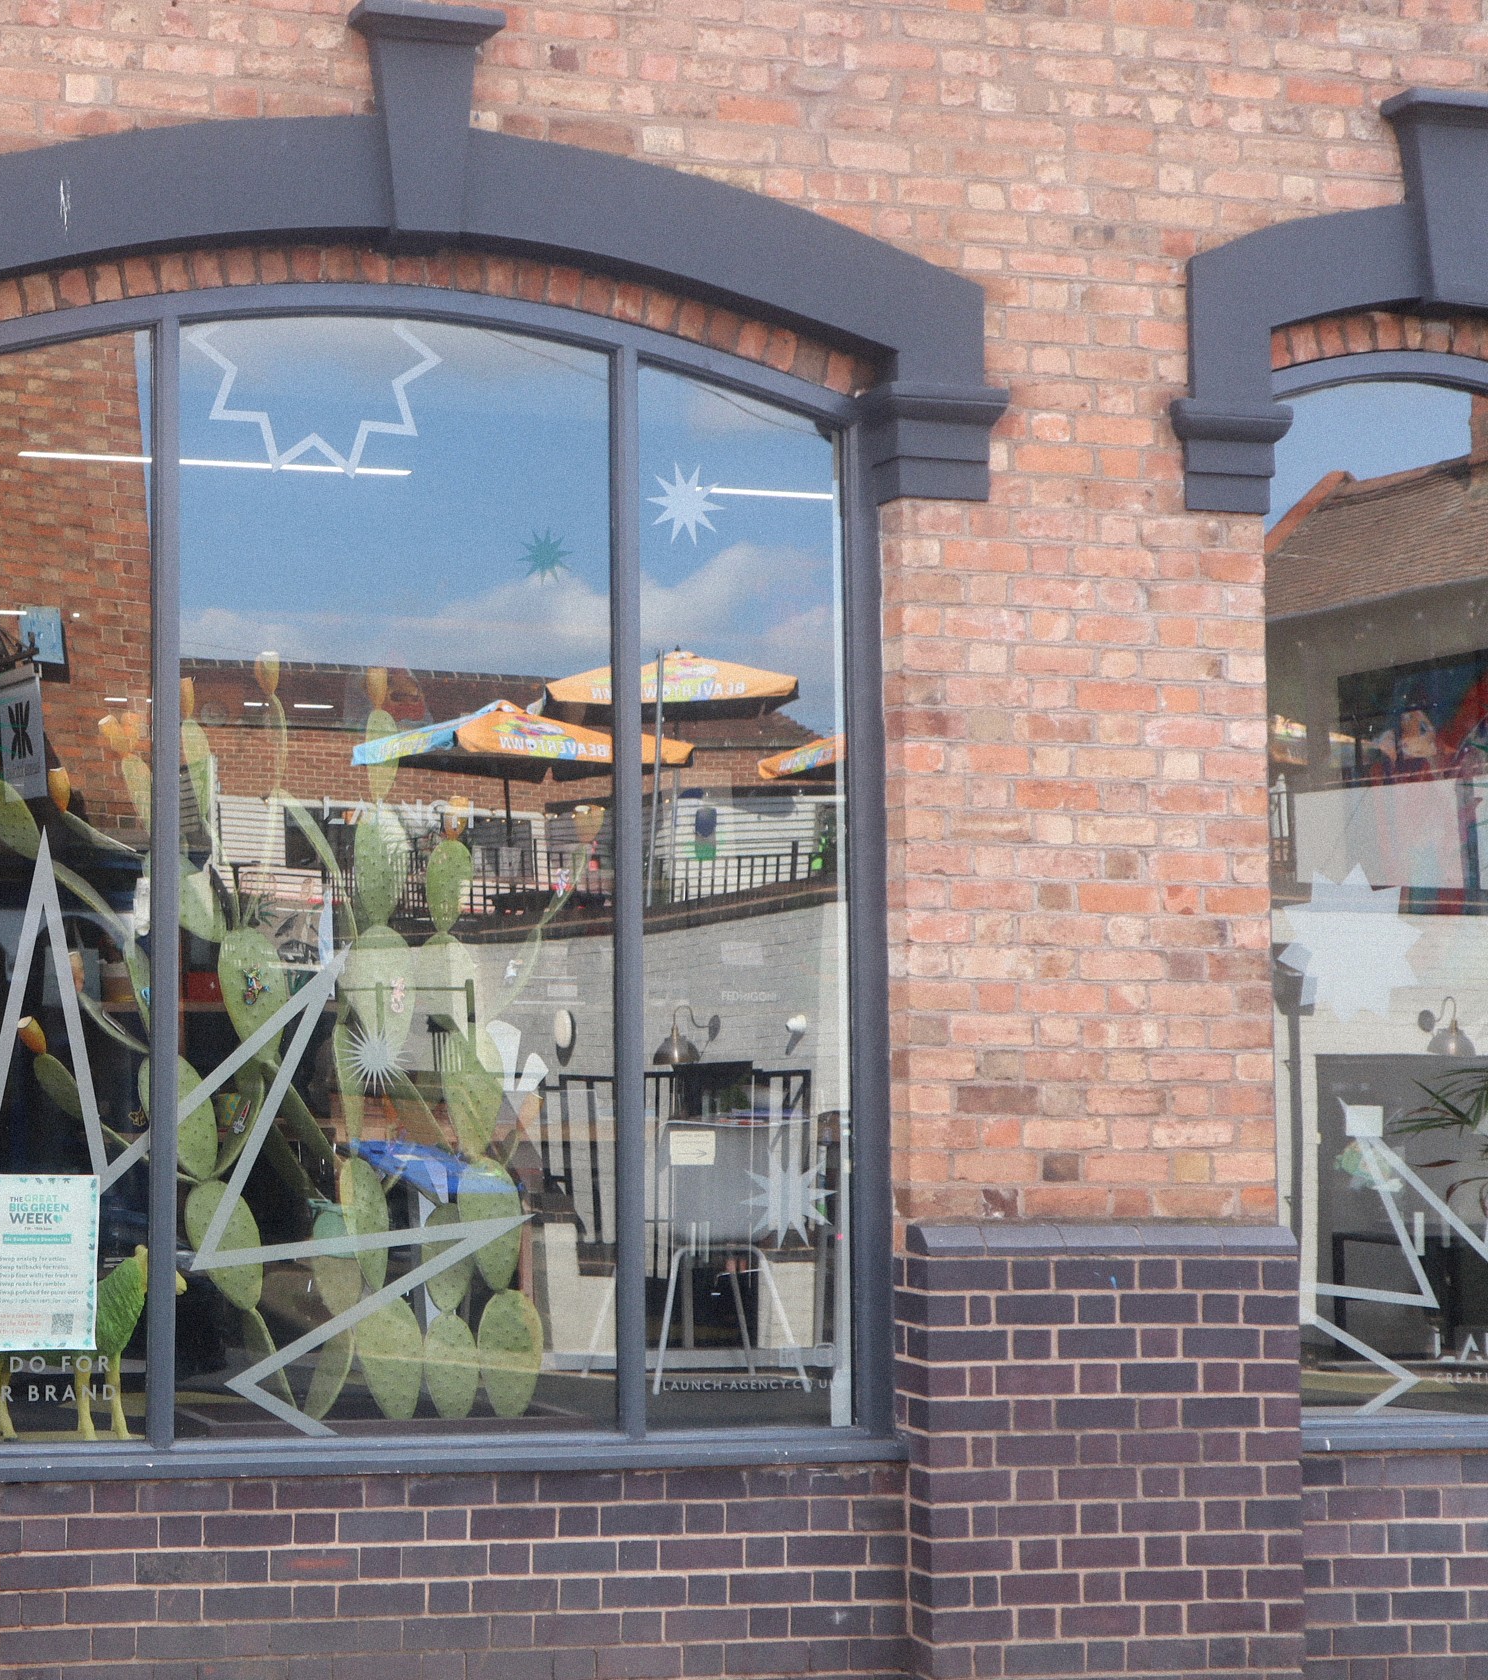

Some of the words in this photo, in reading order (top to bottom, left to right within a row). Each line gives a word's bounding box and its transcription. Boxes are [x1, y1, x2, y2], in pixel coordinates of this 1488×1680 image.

[24, 1194, 58, 1203] GREAT
[9, 1203, 28, 1212] BIG
[31, 1203, 70, 1212] GREEN
[9, 1212, 53, 1224] WEEK
[10, 1356, 46, 1373] DO
[62, 1355, 111, 1373] FOR
[28, 1384, 117, 1402] BRAND
